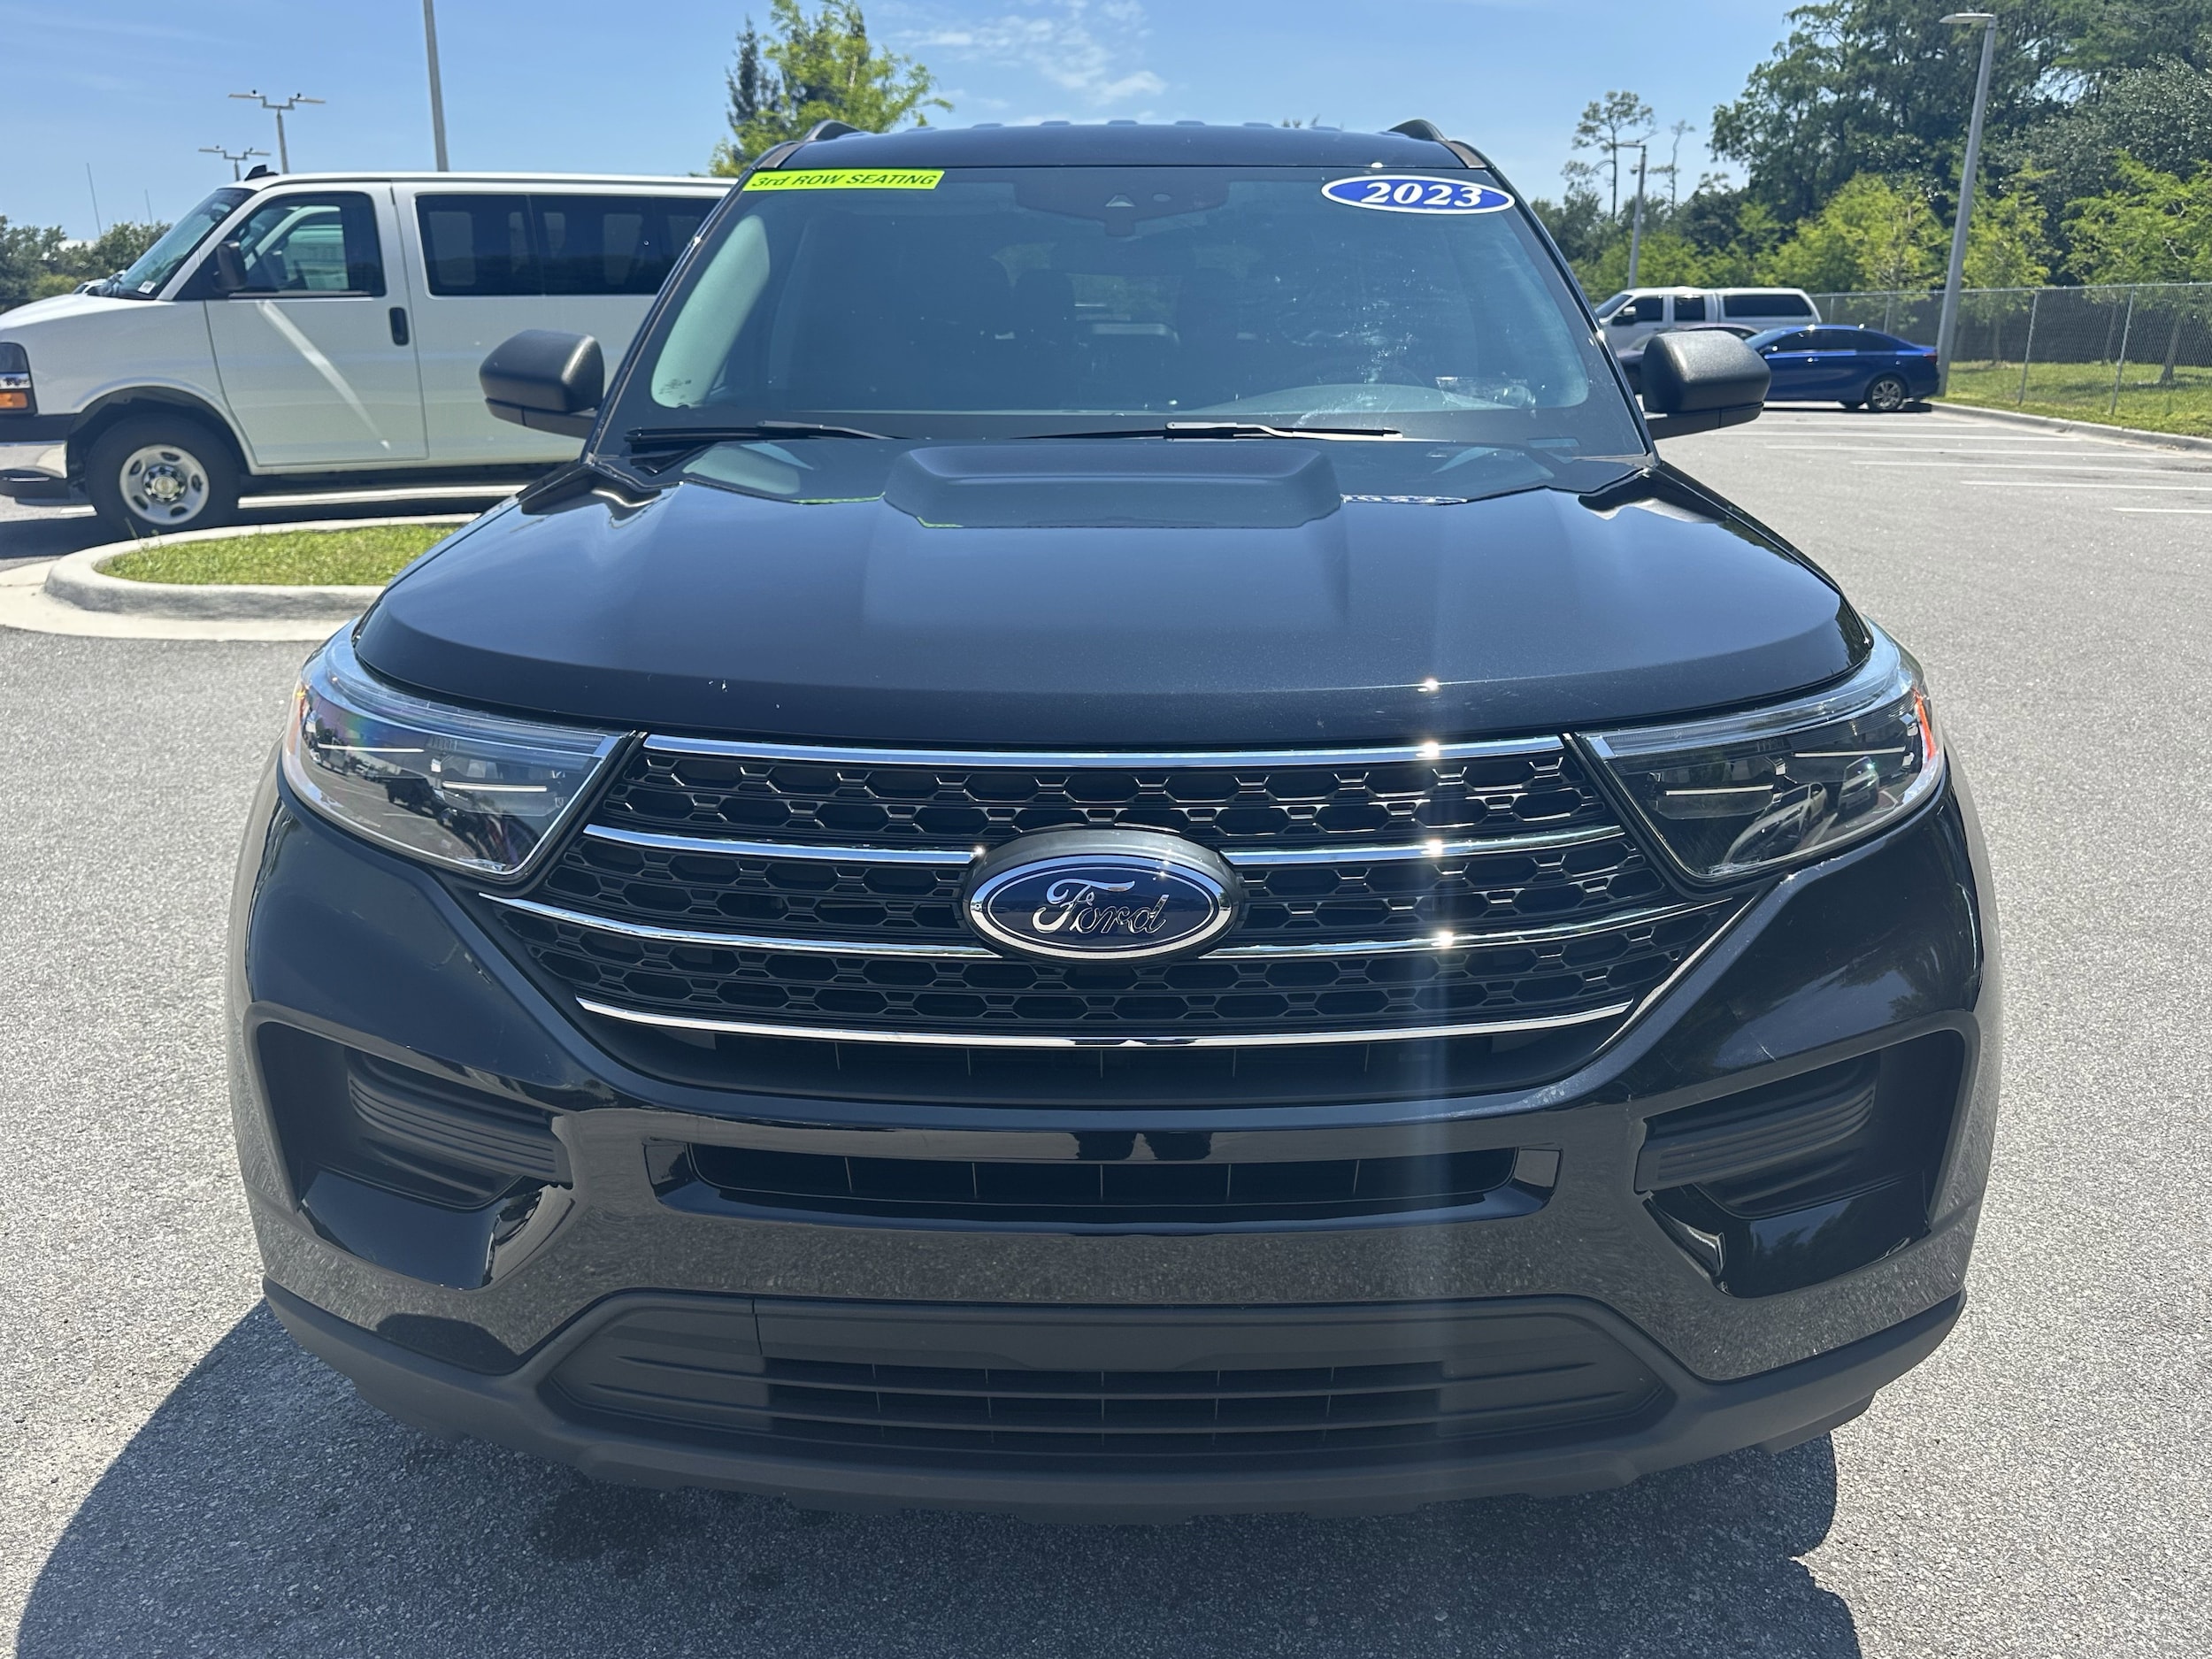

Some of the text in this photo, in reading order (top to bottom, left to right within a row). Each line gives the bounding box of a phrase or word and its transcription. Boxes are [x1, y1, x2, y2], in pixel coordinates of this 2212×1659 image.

[752, 174, 938, 187] 3rd ROW SEATING
[1360, 182, 1483, 207] 2023
[1032, 878, 1170, 934] Ford
